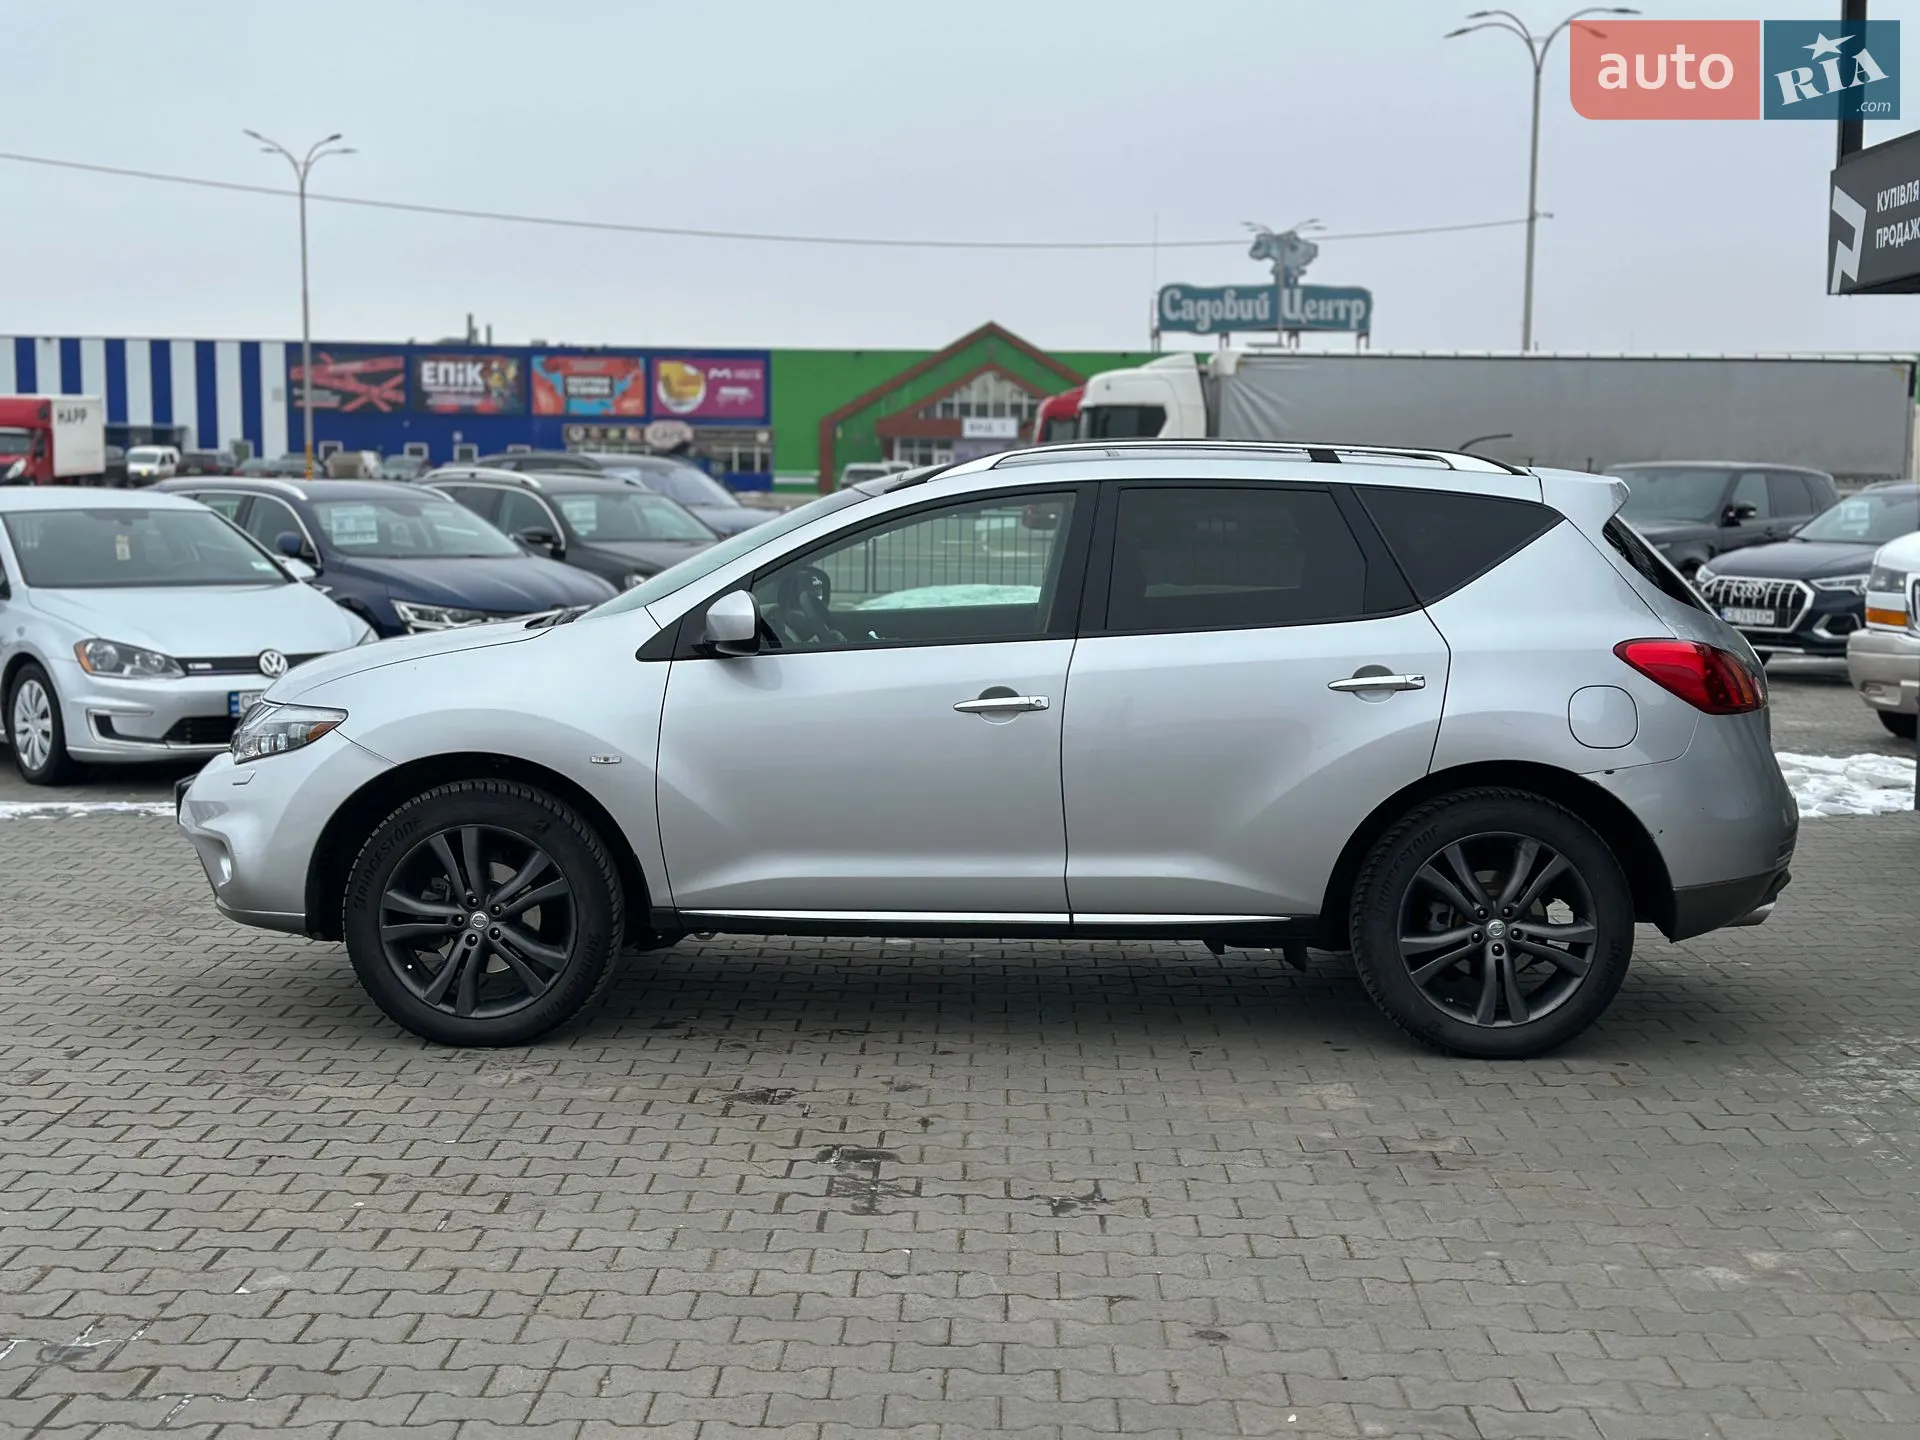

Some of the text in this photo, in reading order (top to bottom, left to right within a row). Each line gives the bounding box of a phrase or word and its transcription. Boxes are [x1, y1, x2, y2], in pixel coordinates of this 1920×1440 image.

[1876, 179, 1920, 213] КУПІВЛЯ
[1876, 216, 1920, 249] ПРОДАЖ
[1161, 287, 1367, 331] Садовий Центр
